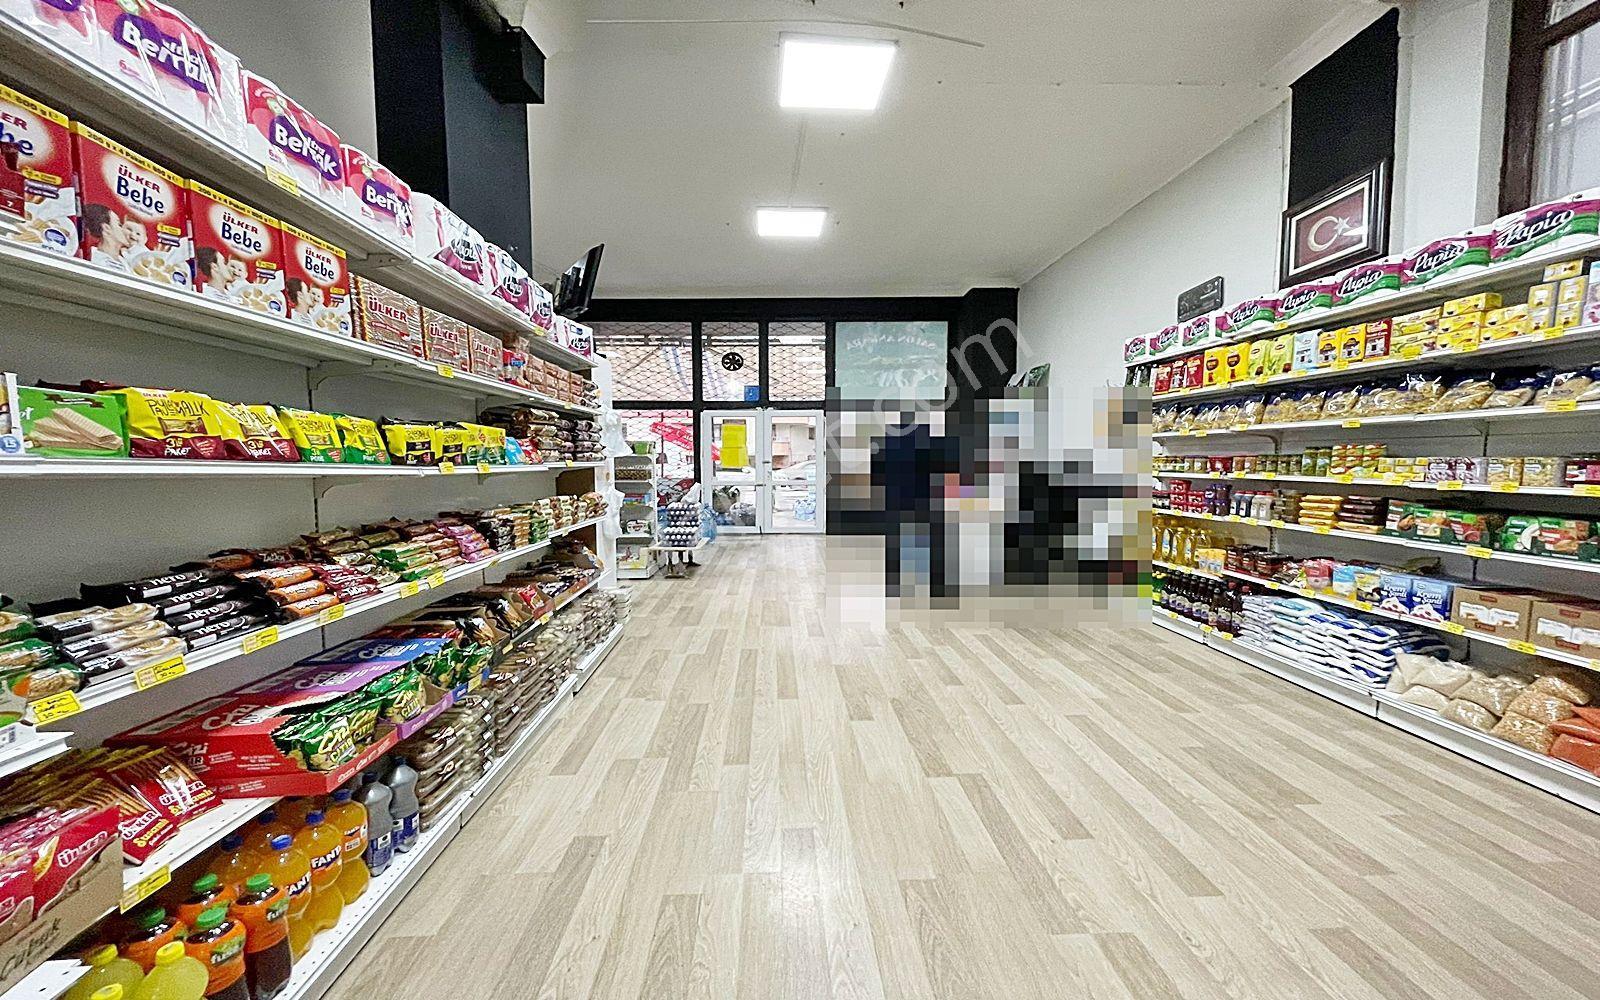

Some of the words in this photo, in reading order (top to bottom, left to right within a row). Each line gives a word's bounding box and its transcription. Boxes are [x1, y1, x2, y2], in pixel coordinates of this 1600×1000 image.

[118, 164, 161, 193] ÜLKER
[117, 176, 164, 213] Bebe
[223, 211, 258, 234] ÜLKER
[1497, 211, 1574, 249] Papia
[221, 222, 262, 252] Bebe
[305, 247, 332, 265] ÜLKER
[1413, 242, 1468, 276] Papia
[304, 257, 335, 280] Bebe
[1337, 270, 1383, 297] Papia
[368, 297, 407, 323] ÜLKER
[1280, 290, 1318, 312] Papia
[150, 573, 187, 586] nero
[1383, 583, 1406, 593] Krem
[171, 590, 205, 604] nero
[1416, 590, 1442, 600] Krem
[184, 606, 220, 620] nero
[194, 621, 231, 635] nero
